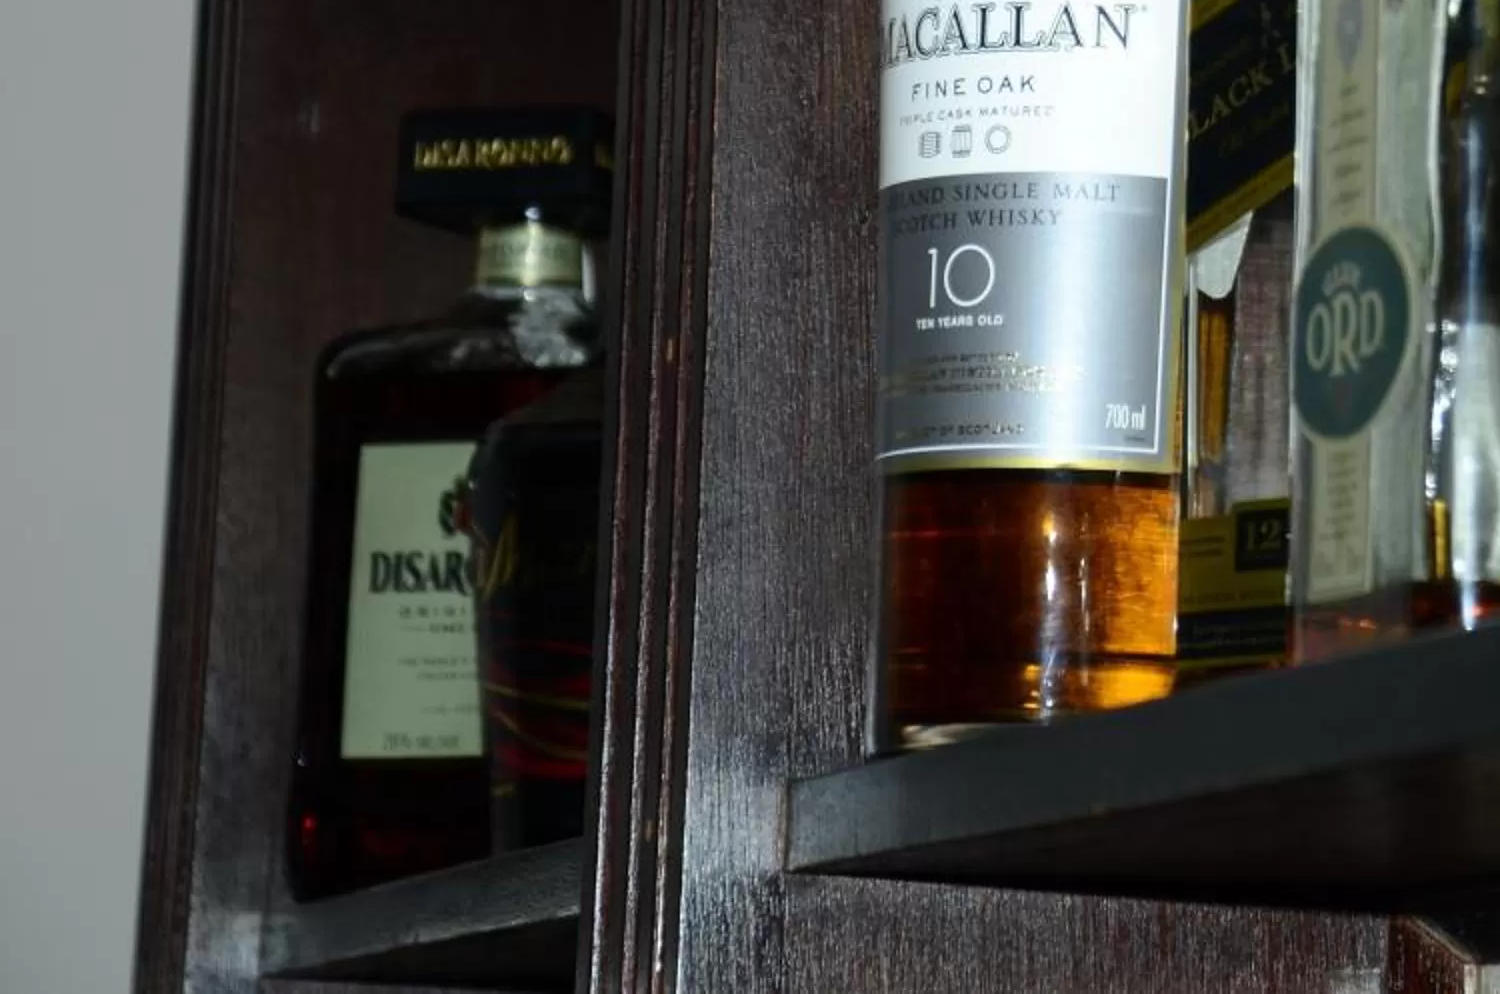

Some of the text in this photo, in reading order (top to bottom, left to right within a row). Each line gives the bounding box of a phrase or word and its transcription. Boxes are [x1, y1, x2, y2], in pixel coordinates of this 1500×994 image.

[880, 0, 1137, 68] MACALLAN
[911, 74, 1036, 102] FINE OAK
[1188, 65, 1274, 142] LACK
[896, 181, 1121, 209] LAND SINGLE MALT
[967, 208, 1063, 227] WHISKY
[927, 243, 996, 309] 10
[915, 314, 1005, 331] TEN YEARS OLD
[1305, 290, 1385, 378] ORD
[1105, 403, 1146, 431] 700 ml
[1246, 517, 1283, 552] 12
[368, 550, 471, 596] DISAR
